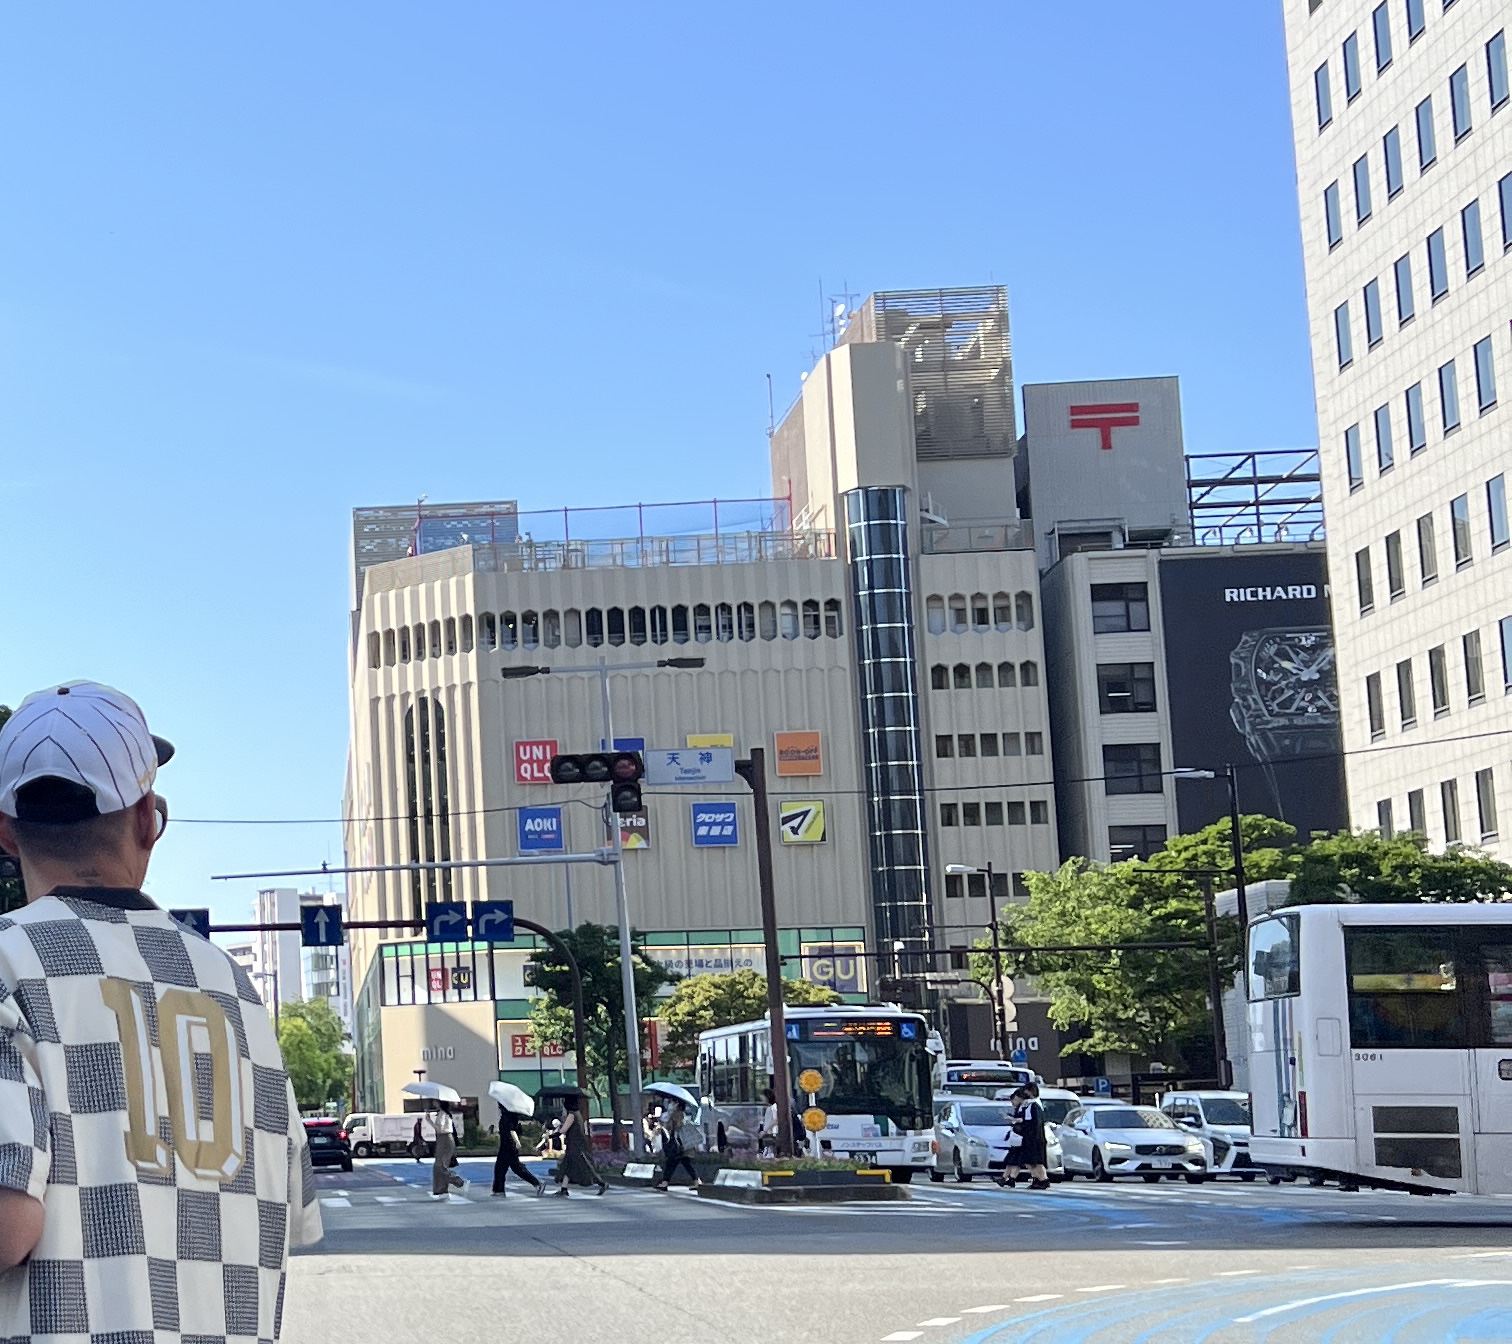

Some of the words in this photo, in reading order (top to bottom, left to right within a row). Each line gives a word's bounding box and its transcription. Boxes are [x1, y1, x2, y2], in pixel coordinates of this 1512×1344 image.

[1224, 584, 1317, 602] RICHARD
[519, 745, 551, 760] UNI
[666, 751, 713, 766] 天神
[524, 818, 557, 831] AOKI
[812, 959, 855, 981] GU
[421, 1045, 455, 1061] mina
[98, 975, 245, 1184] 10
[1098, 1080, 1108, 1092] P
